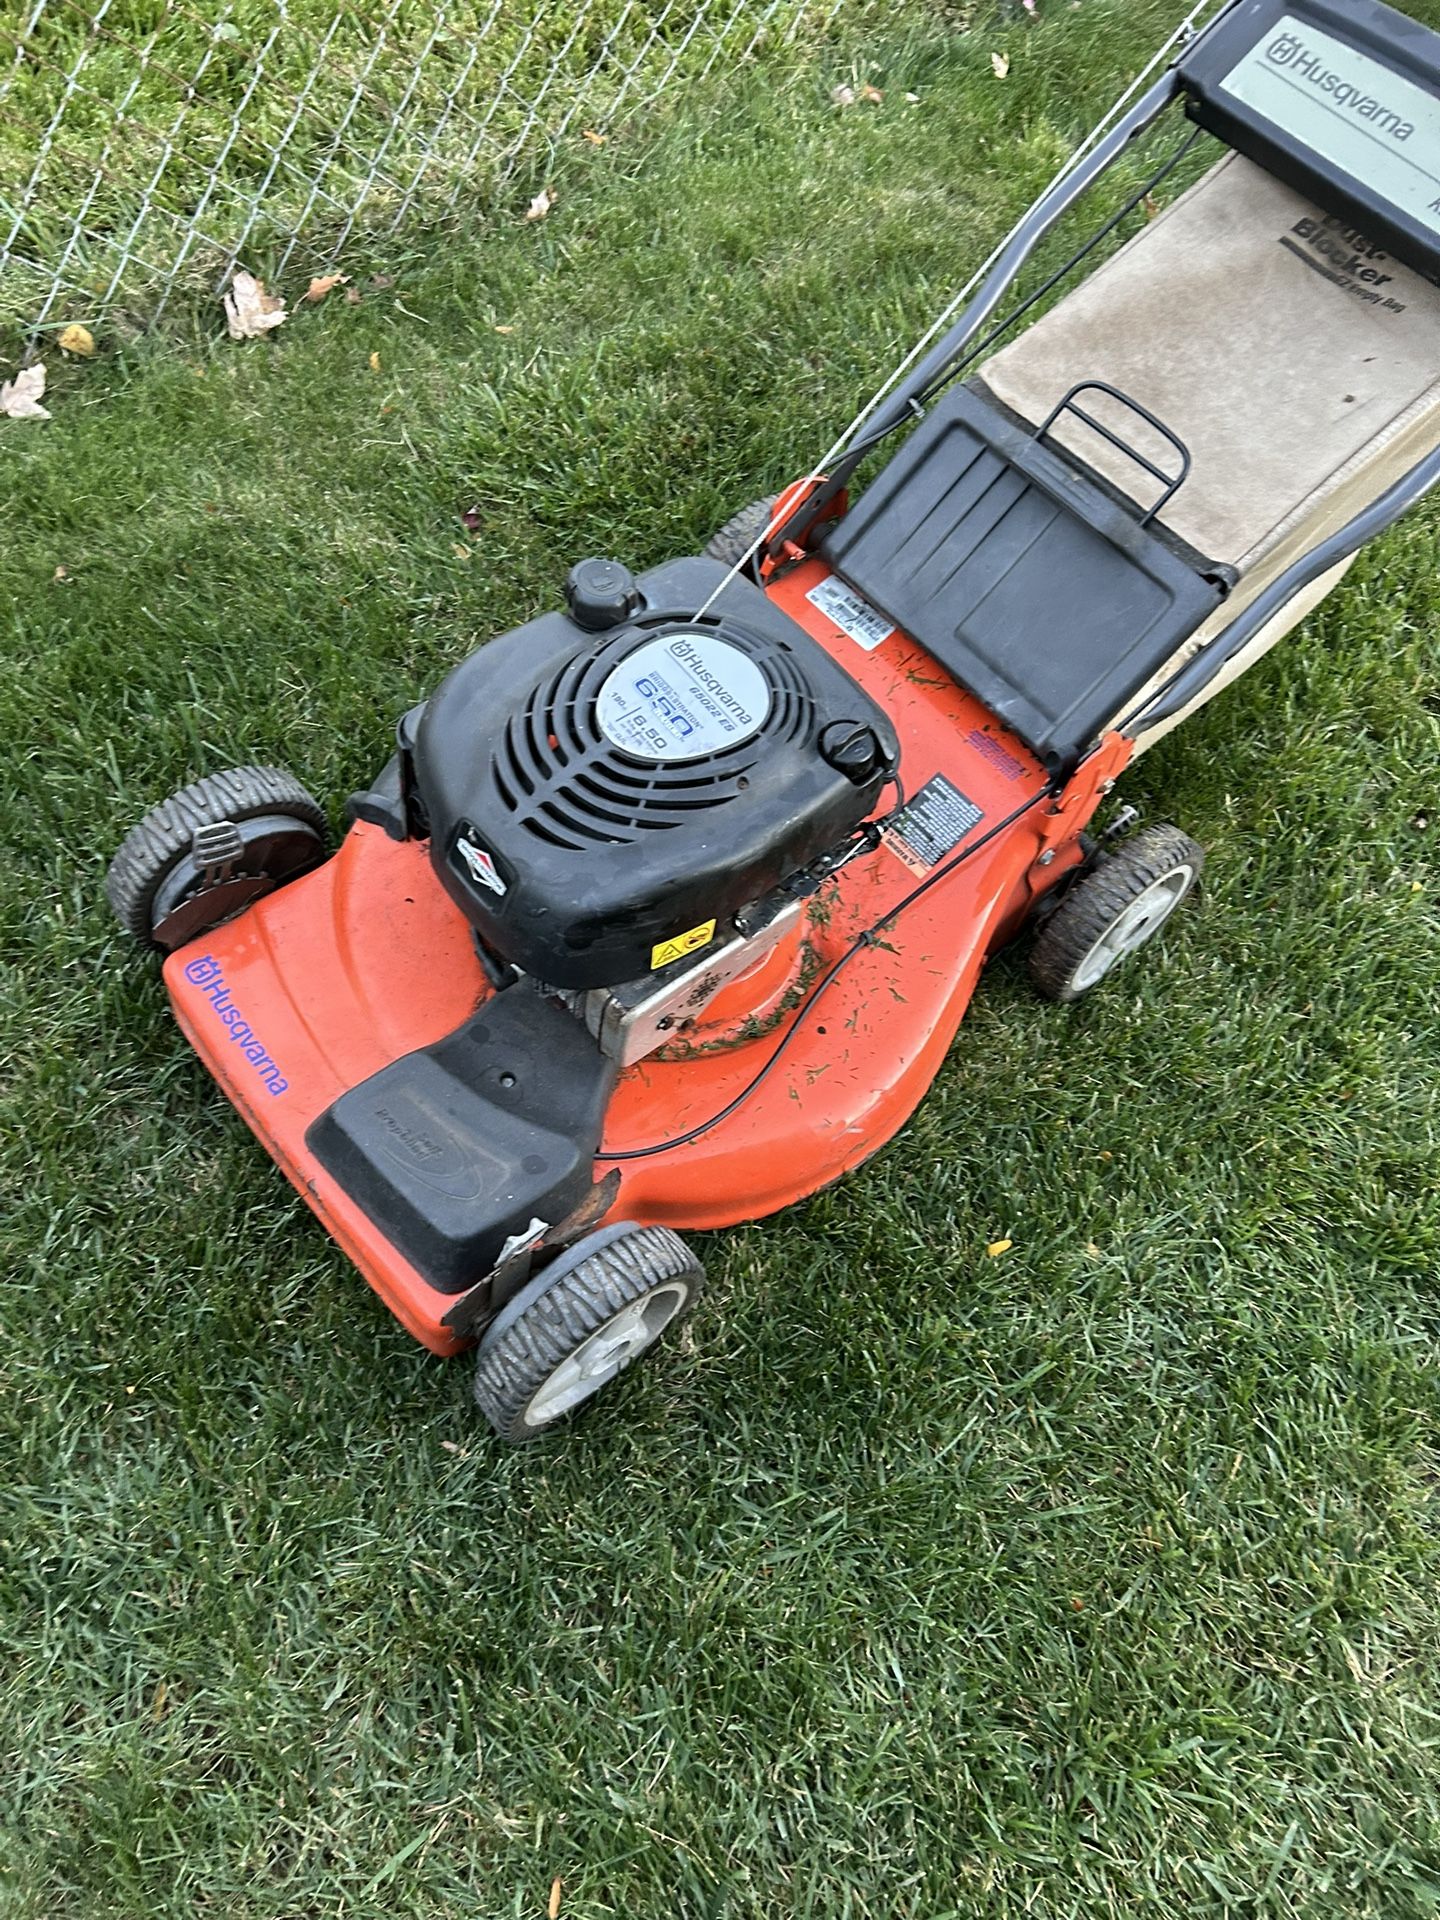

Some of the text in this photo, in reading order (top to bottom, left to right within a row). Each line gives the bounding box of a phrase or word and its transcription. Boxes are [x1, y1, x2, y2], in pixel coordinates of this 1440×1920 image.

[1293, 50, 1416, 142] Husqvarna
[1291, 216, 1394, 286] Blocker
[1381, 296, 1407, 314] Bag
[635, 678, 694, 736] 650
[684, 653, 753, 725] Husqvarna
[633, 715, 668, 749] 6.50
[202, 978, 289, 1096] Husqvarna
